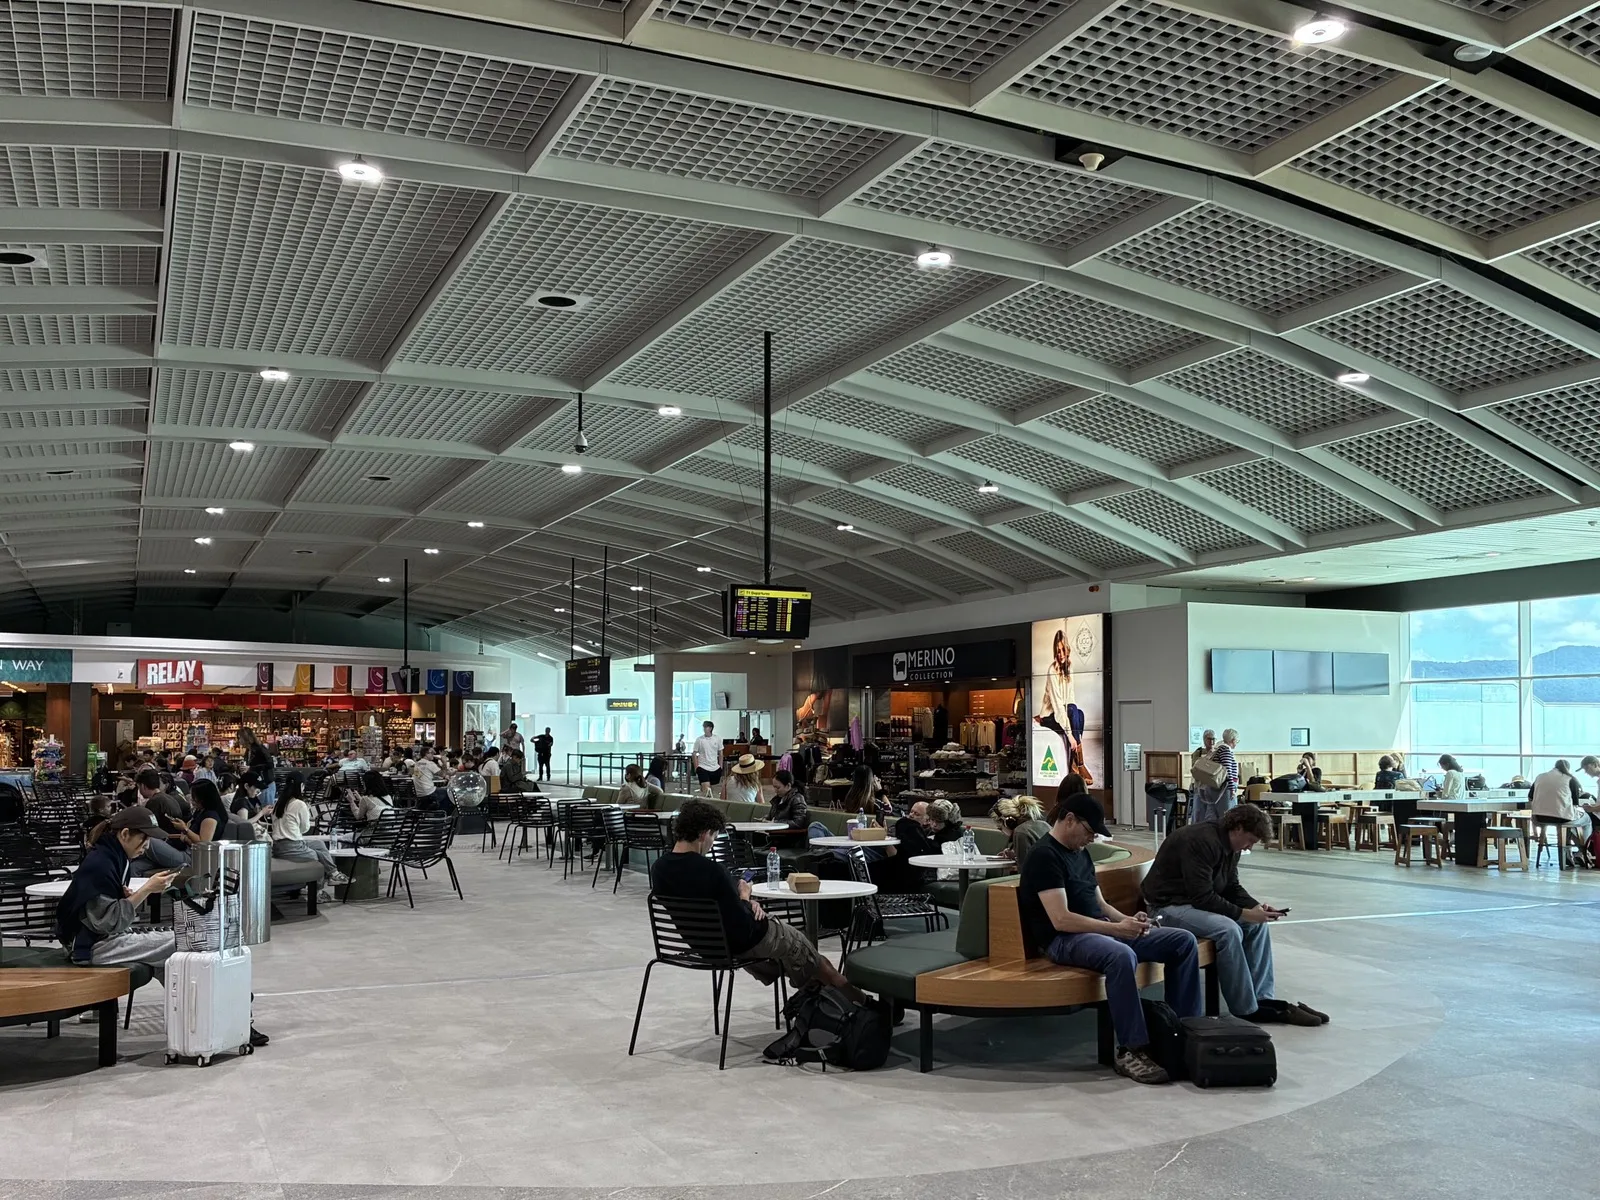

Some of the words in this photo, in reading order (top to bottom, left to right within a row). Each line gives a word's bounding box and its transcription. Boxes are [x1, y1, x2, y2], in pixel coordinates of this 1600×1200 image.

[12, 659, 44, 671] WAY
[908, 647, 955, 668] MERINO
[147, 660, 197, 685] RELAY
[909, 671, 953, 681] COLLECTION
